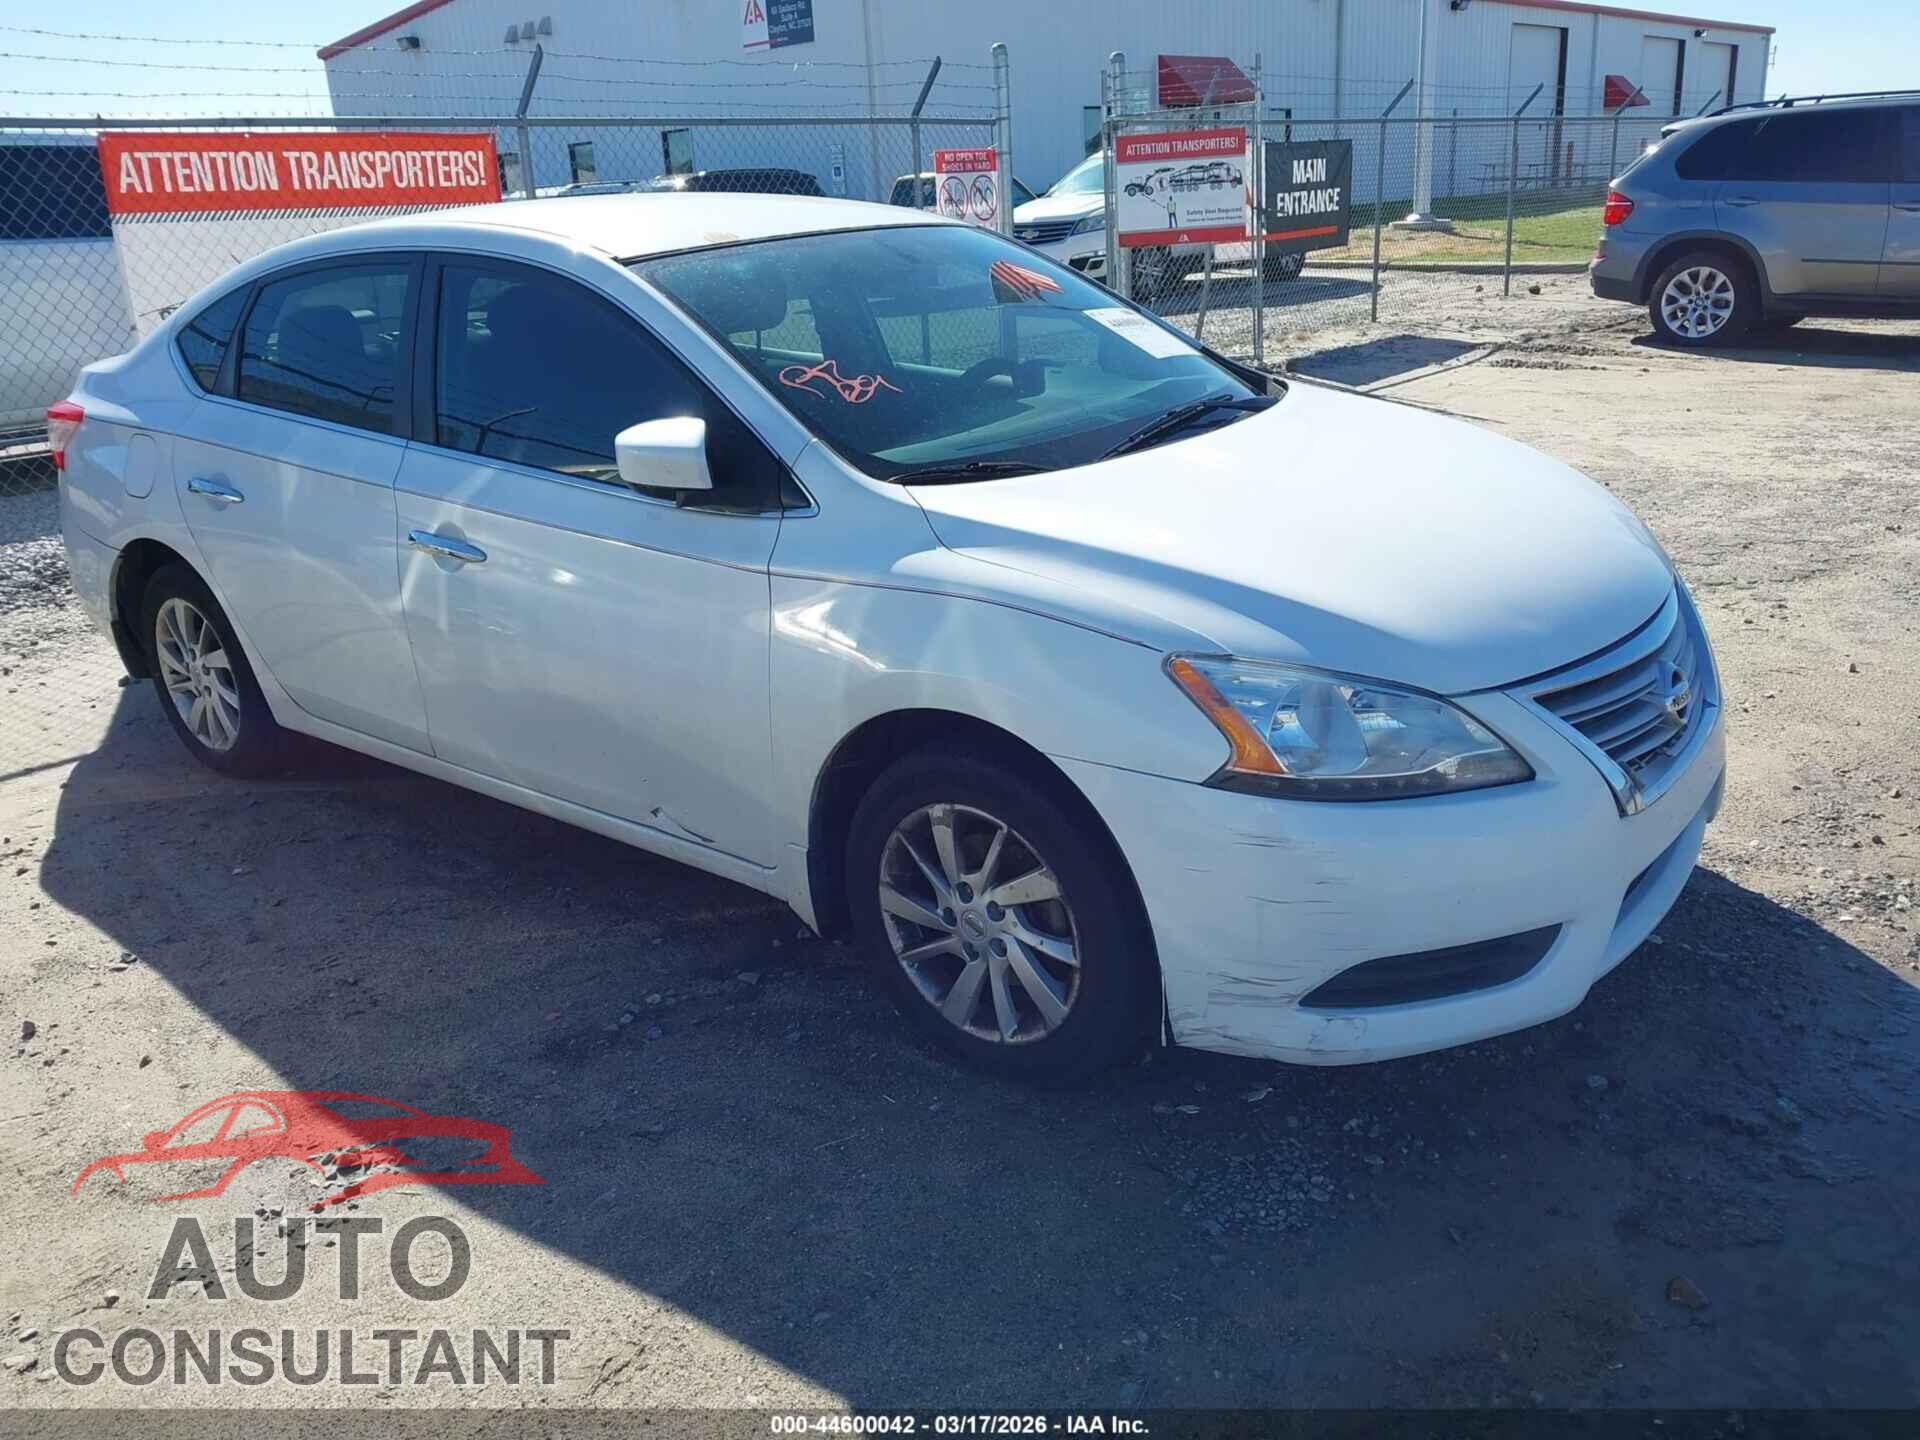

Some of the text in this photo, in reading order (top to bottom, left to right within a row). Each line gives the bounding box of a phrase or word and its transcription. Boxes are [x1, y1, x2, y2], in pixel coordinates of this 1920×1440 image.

[944, 153, 954, 161] NO
[956, 152, 973, 161] OPEN
[1126, 136, 1239, 157] ATTENTION TRANSPORTERS!
[120, 149, 487, 193] ATTENTION TRANSPORTERS!
[1293, 158, 1326, 184] MAIN
[1277, 188, 1340, 217] ENTRANCE
